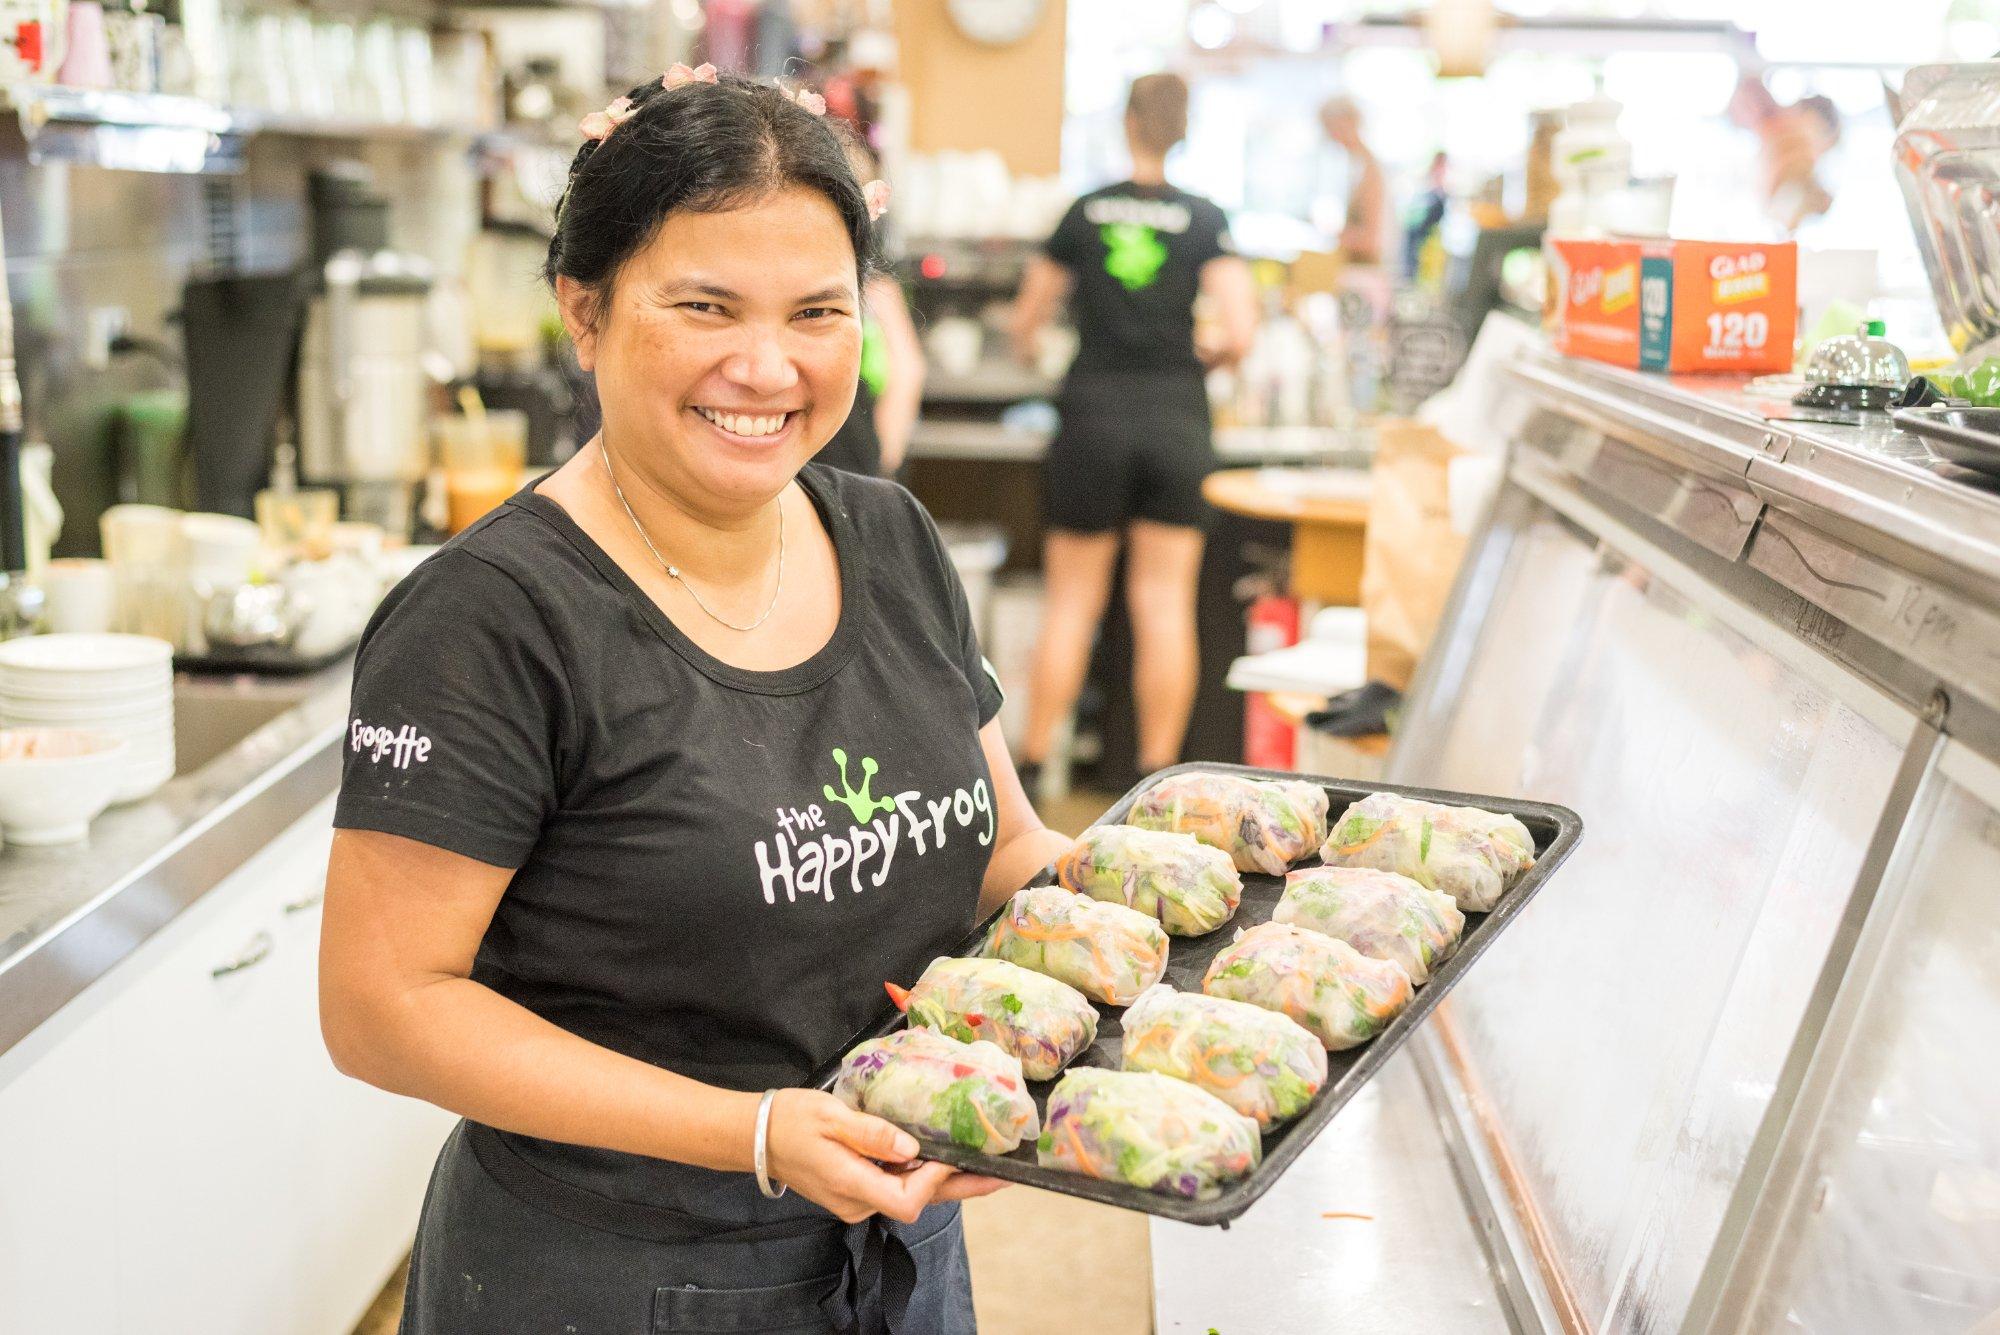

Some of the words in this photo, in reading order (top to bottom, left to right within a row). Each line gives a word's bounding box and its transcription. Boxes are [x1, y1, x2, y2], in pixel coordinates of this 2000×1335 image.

[1706, 311, 1769, 349] 120
[776, 803, 826, 847] the
[754, 813, 899, 905] Happy
